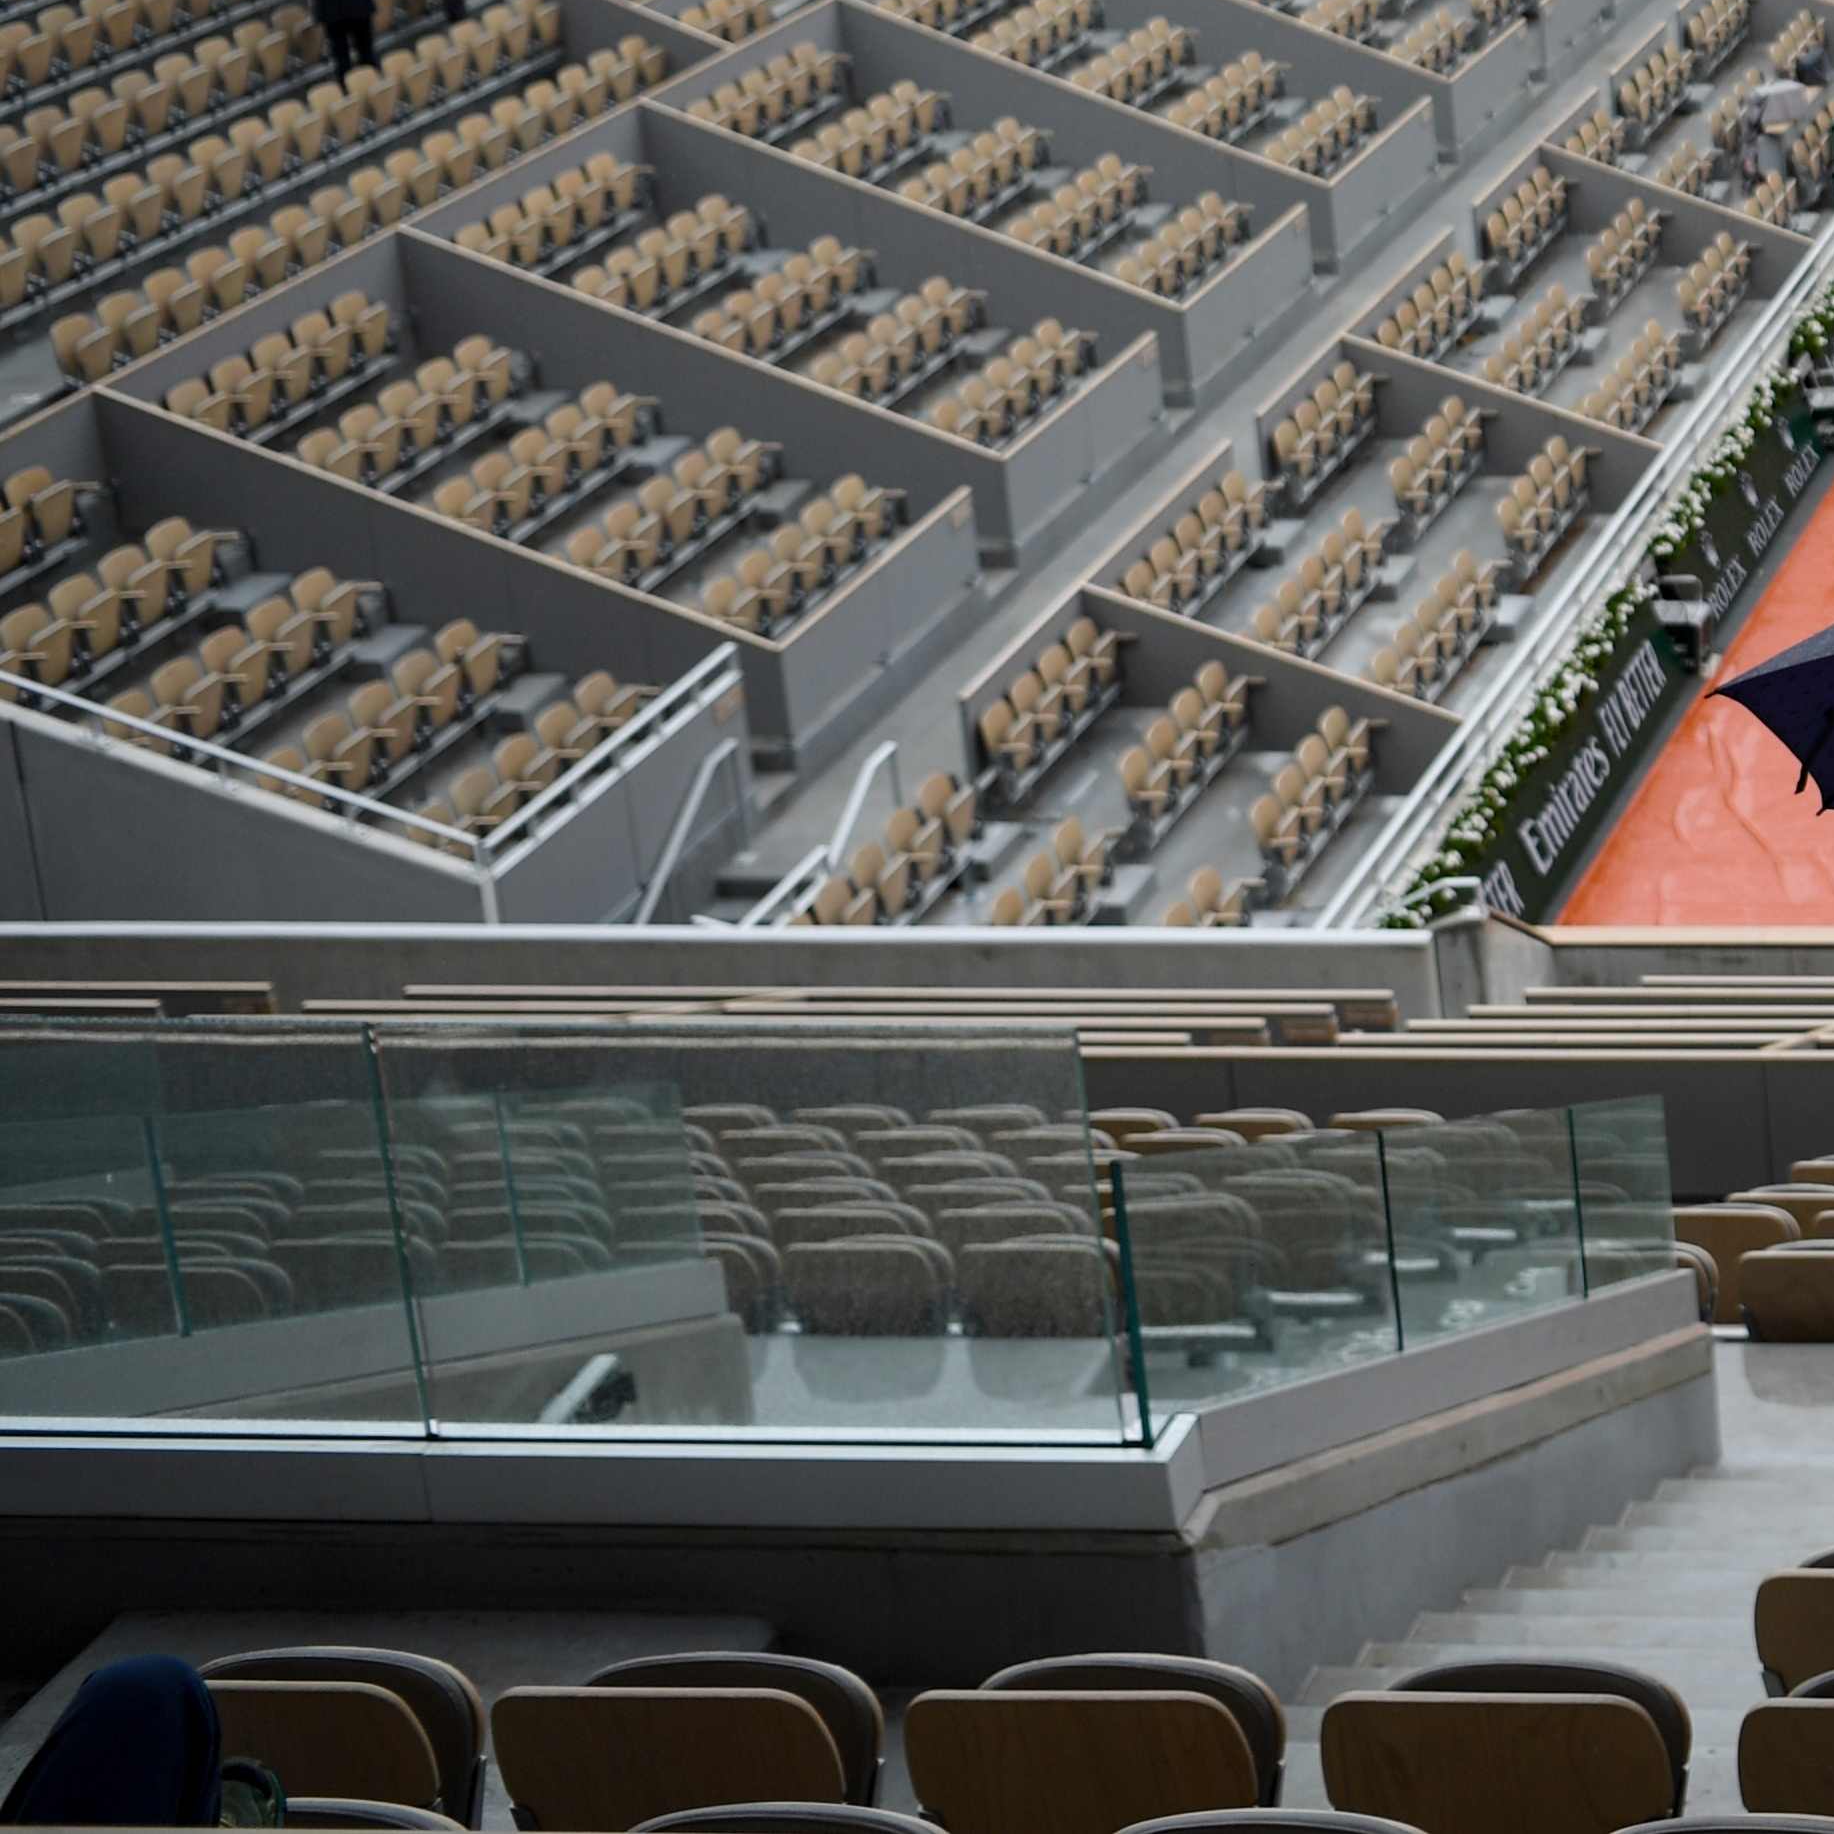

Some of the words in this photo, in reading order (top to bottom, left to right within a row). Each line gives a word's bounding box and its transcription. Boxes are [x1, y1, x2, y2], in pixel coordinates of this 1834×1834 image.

[1598, 690, 1633, 758] FLY
[1615, 639, 1667, 732] BETTER
[1518, 735, 1611, 877] Emirates
